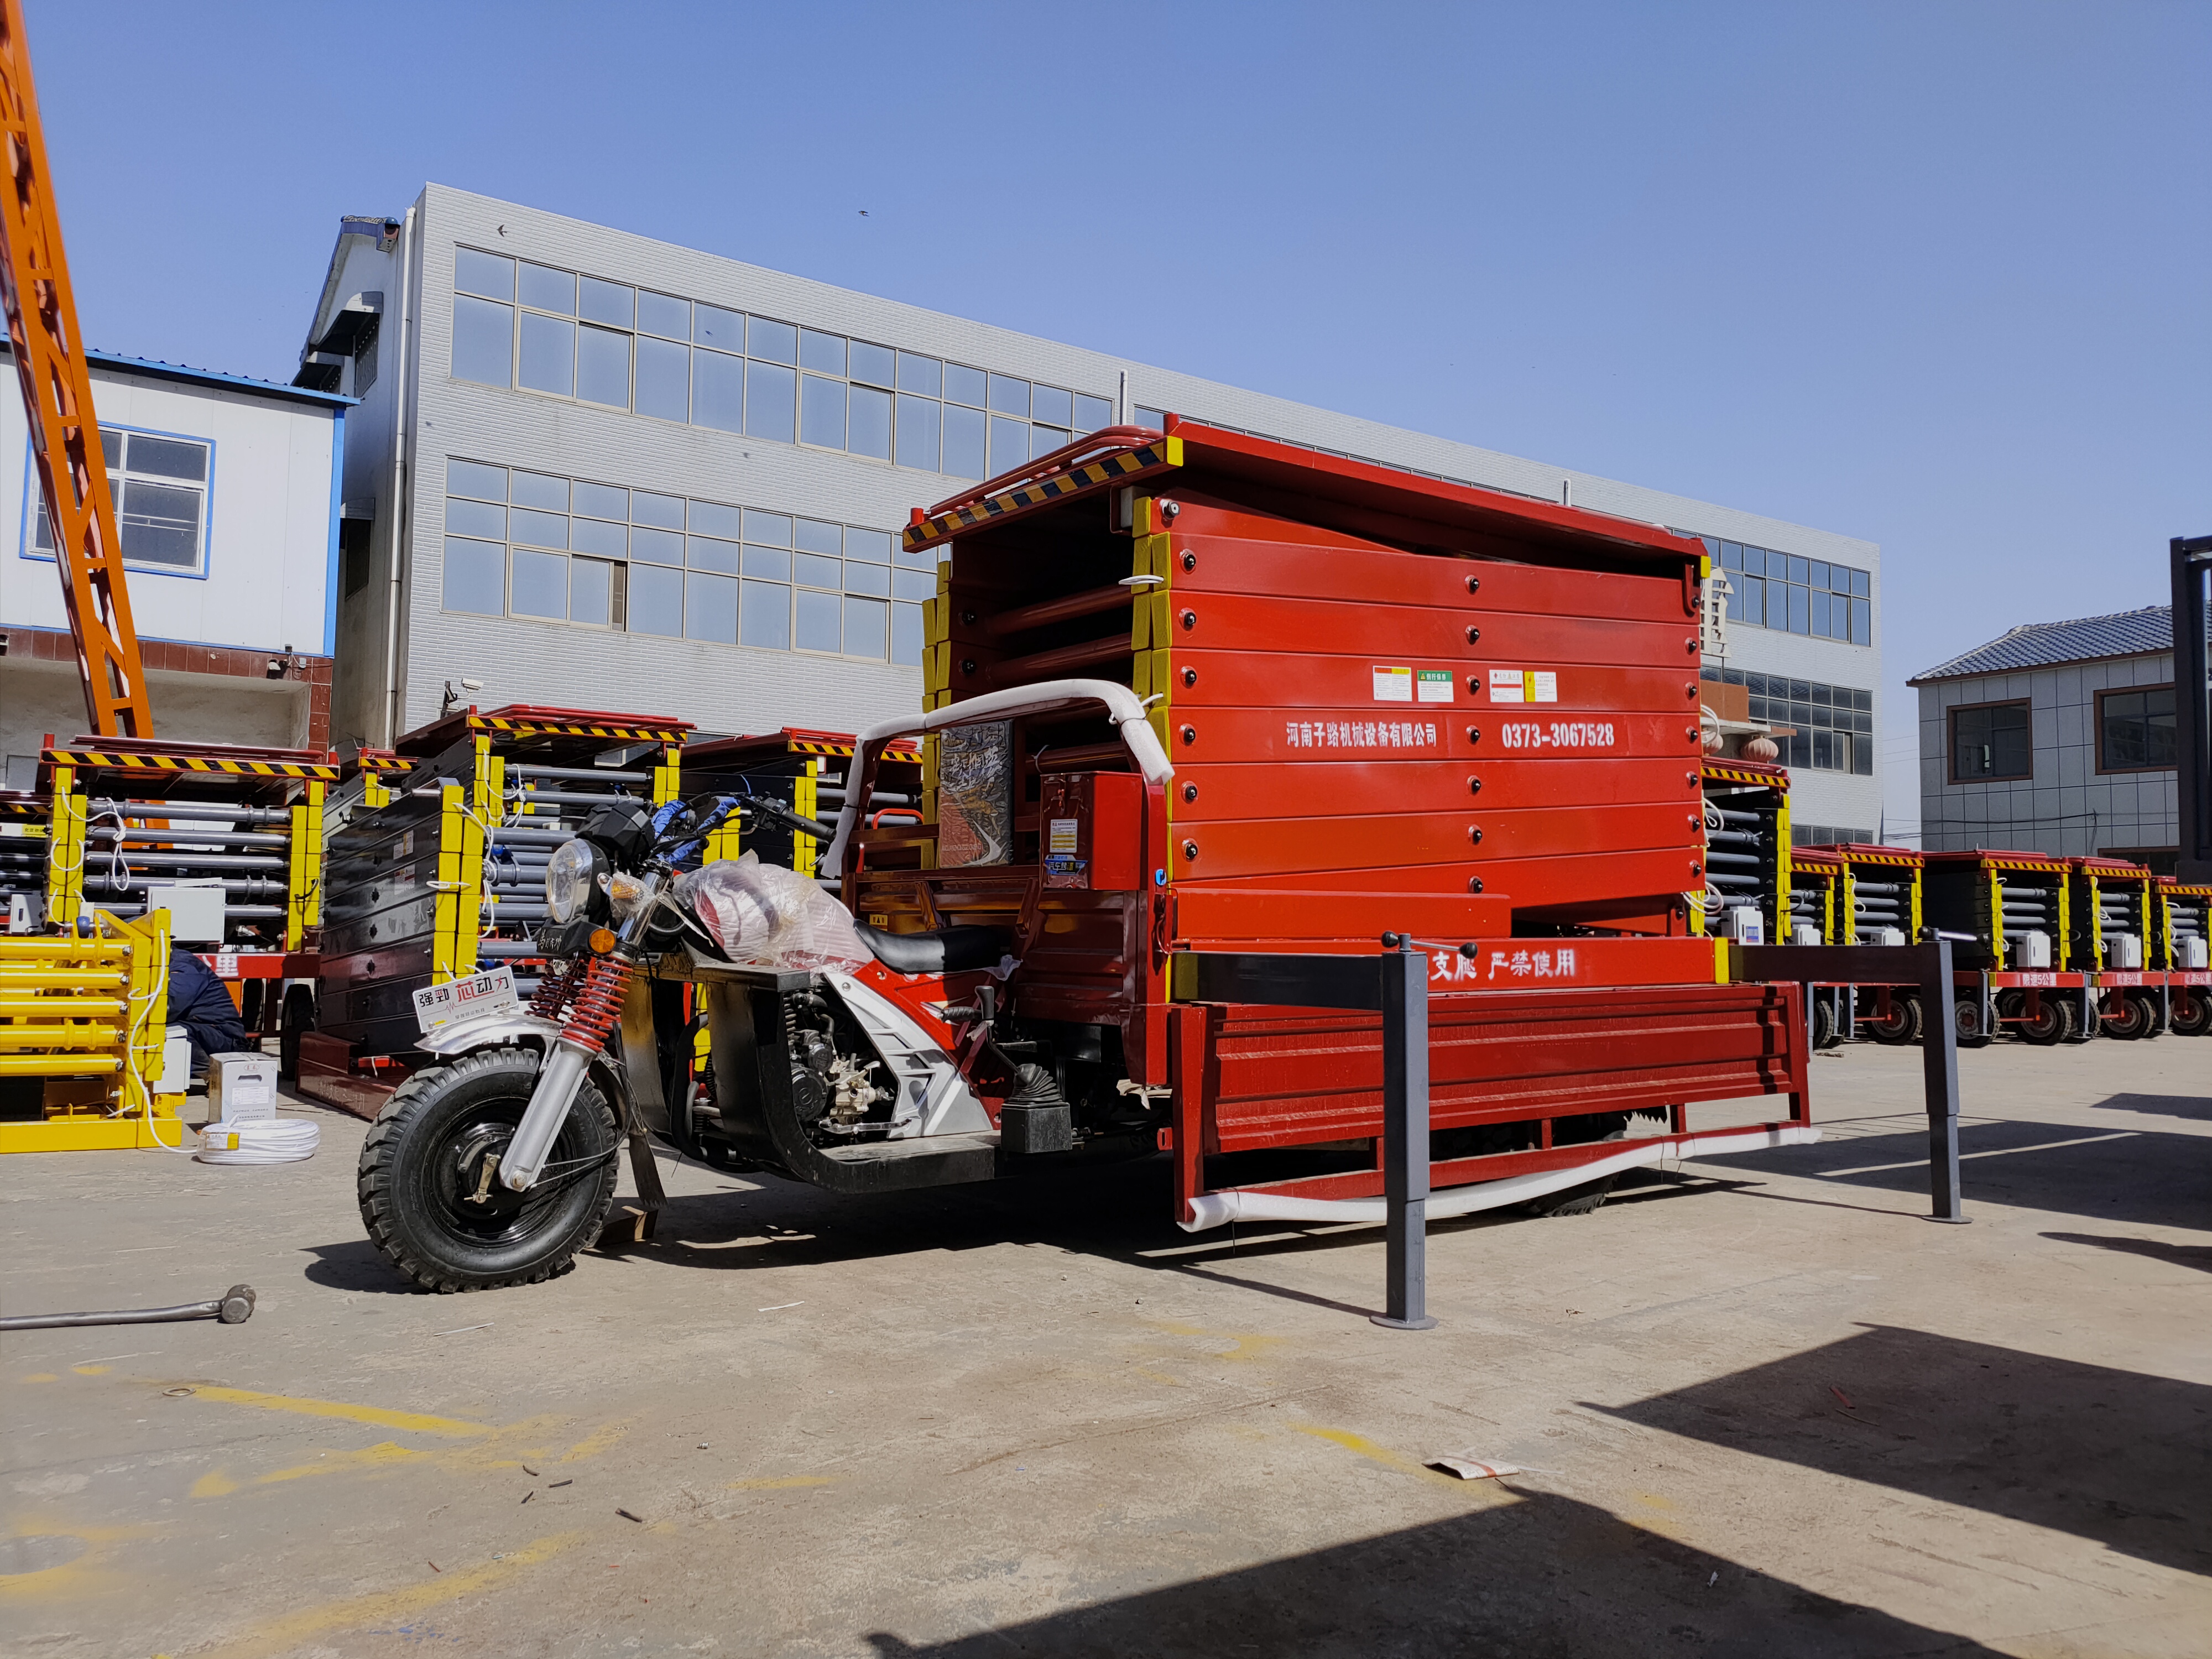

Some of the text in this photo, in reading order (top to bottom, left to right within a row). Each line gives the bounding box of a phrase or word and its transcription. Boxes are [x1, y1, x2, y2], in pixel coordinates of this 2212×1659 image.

[1286, 721, 1437, 747] 河南子路机械设备有限公司
[1502, 722, 1614, 748] 0373-3067528
[1427, 948, 1575, 981] 支腿 严禁使用
